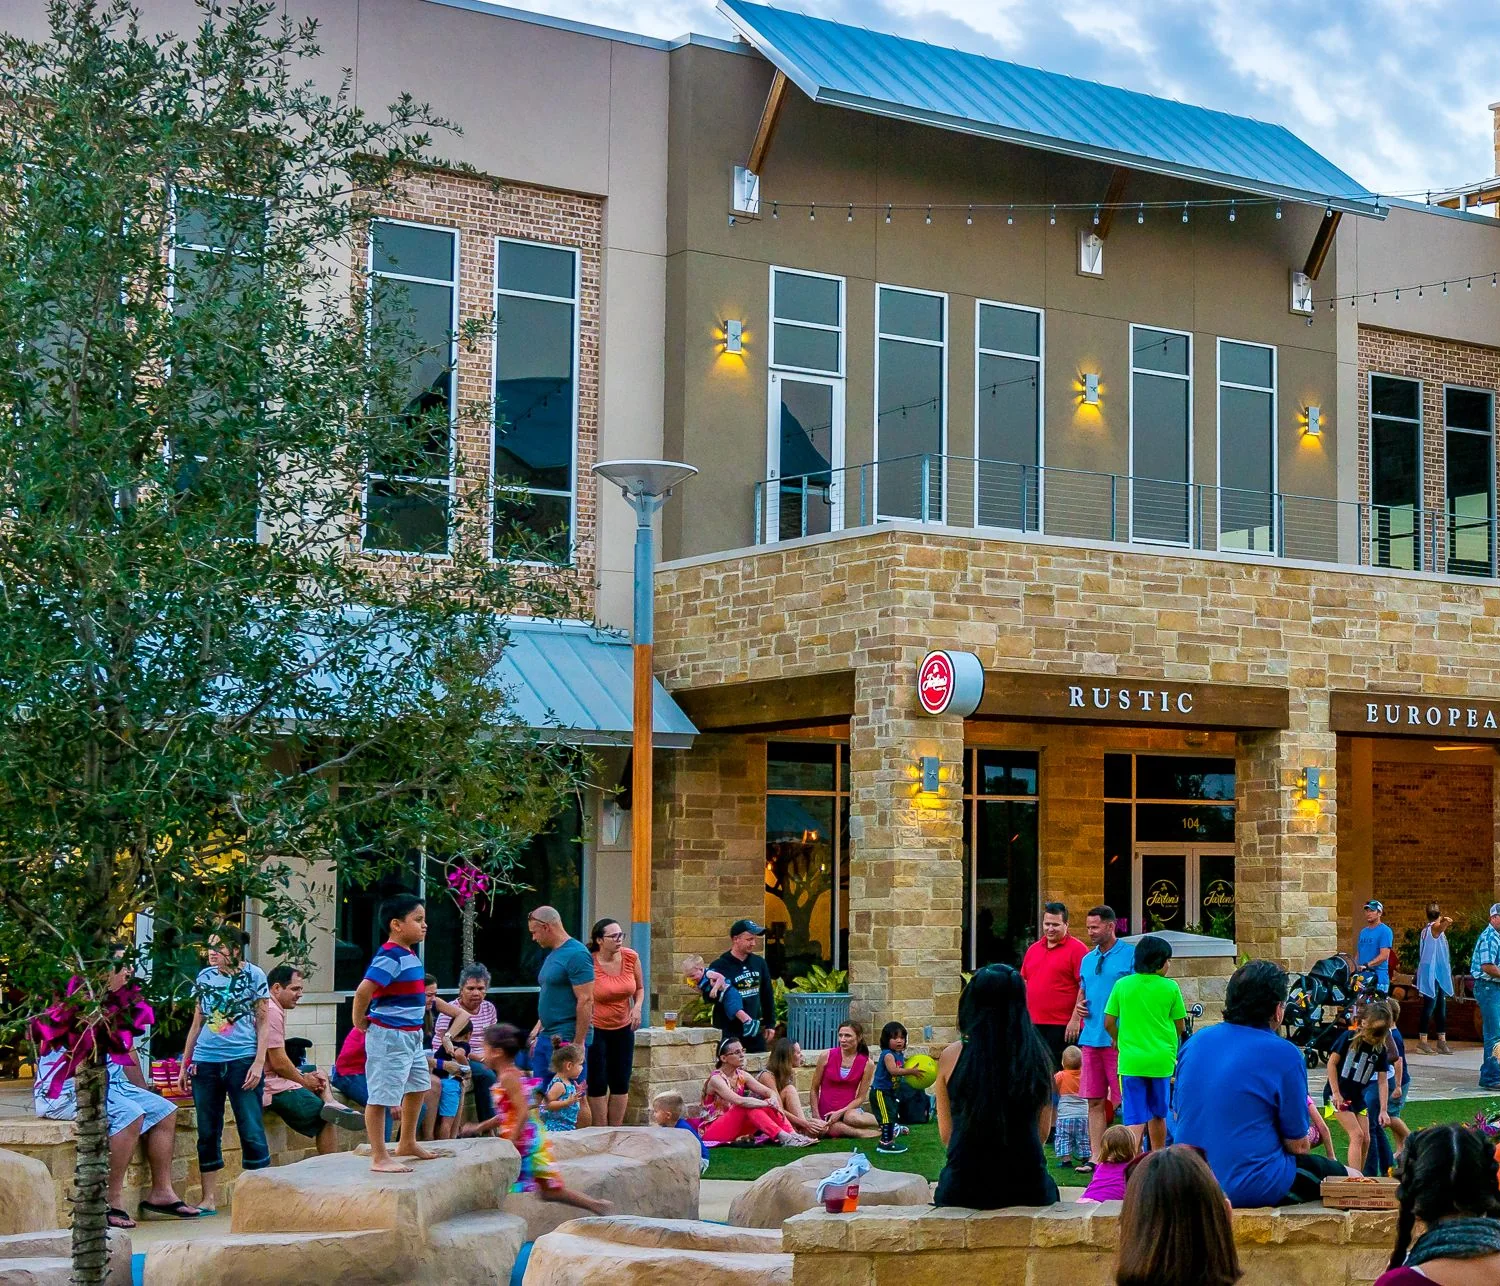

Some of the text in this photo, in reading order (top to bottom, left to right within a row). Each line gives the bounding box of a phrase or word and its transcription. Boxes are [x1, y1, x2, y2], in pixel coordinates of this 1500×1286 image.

[1069, 686, 1193, 714] RUSTIC
[1183, 818, 1200, 829] 104
[1341, 1049, 1379, 1085] Hi
